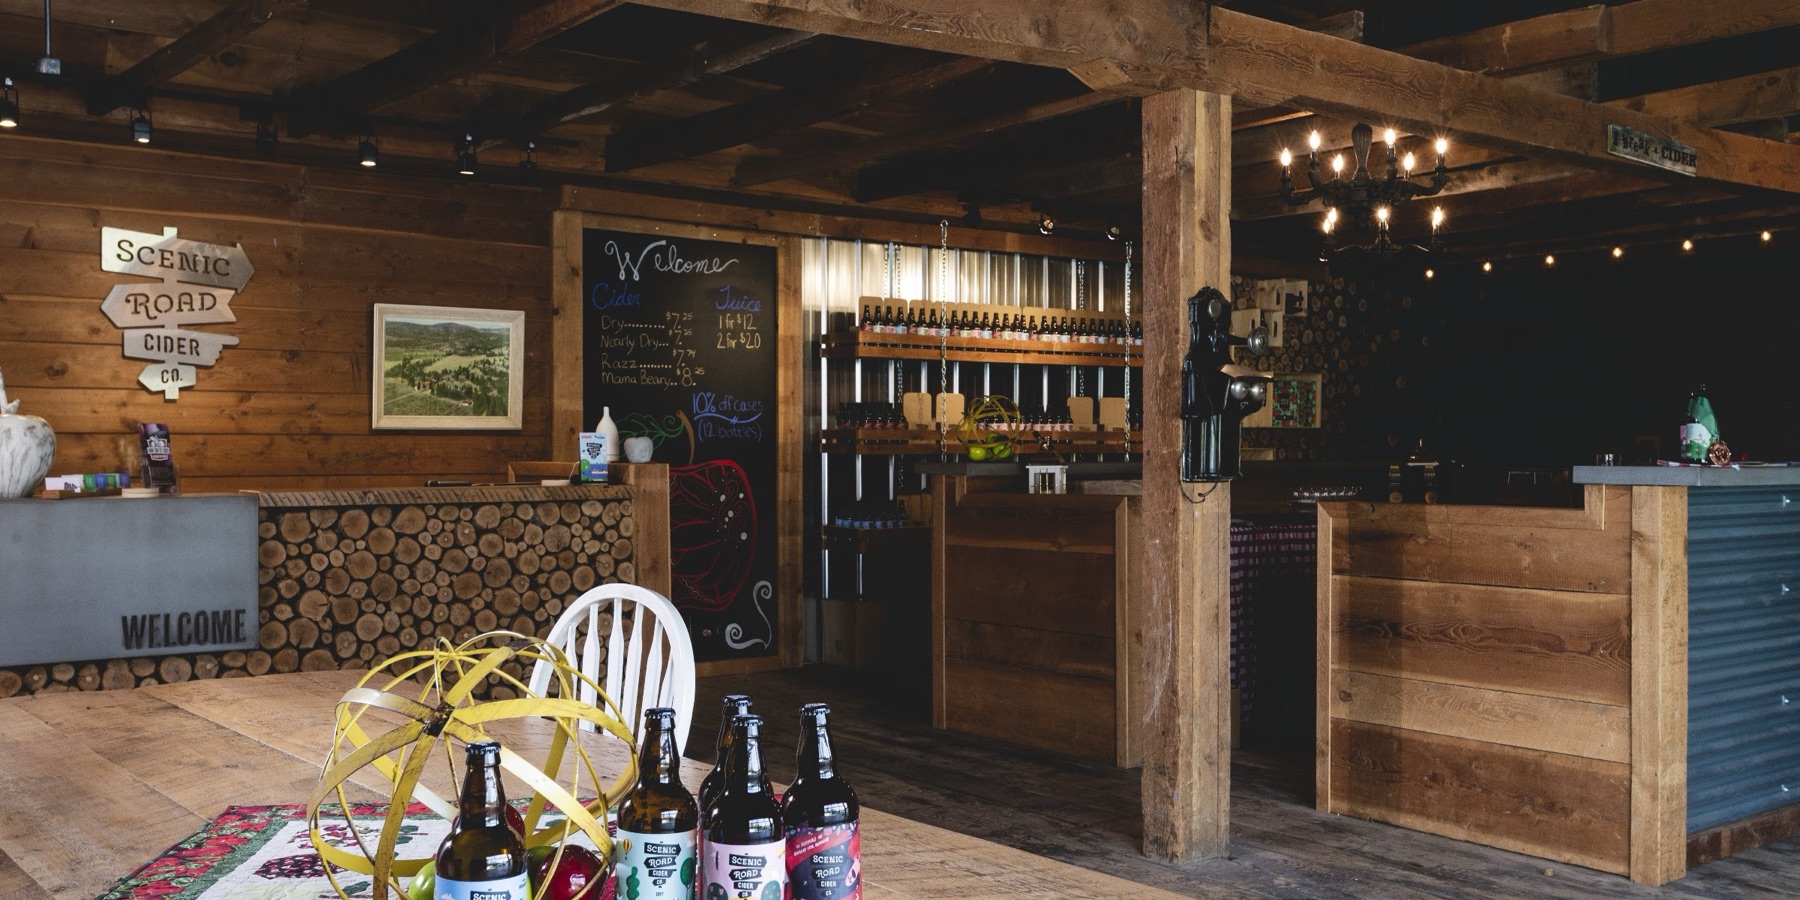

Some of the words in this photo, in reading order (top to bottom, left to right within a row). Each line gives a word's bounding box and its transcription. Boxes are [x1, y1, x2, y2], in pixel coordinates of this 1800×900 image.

[1661, 146, 1696, 167] CIDER
[116, 239, 231, 277] SCENIC
[605, 240, 739, 281] Welcome
[592, 282, 641, 310] Cider
[715, 285, 762, 312] Juice
[124, 292, 217, 320] ROAD
[719, 314, 723, 329] 1
[736, 313, 757, 330] $12
[144, 333, 201, 356] CIDER
[600, 334, 636, 356] Nearly
[717, 332, 726, 349] 2
[726, 332, 738, 349] for
[740, 332, 761, 349] $20
[161, 368, 183, 384] CO.
[602, 371, 638, 385] Mama
[692, 391, 716, 414] 10%
[719, 394, 733, 411] off
[734, 399, 764, 412] cases
[698, 418, 715, 442] (12
[719, 421, 762, 443] bottles)
[121, 609, 247, 650] WELCOME
[646, 844, 677, 854] SCENIC
[648, 857, 673, 868] ROAD
[731, 856, 762, 866] SCENIC
[812, 854, 844, 864] SCENIC
[652, 869, 668, 877] CIDER
[733, 869, 758, 880] ROAD
[815, 866, 841, 879] ROAD
[737, 882, 754, 890] CIDER
[820, 880, 837, 888] CIDER
